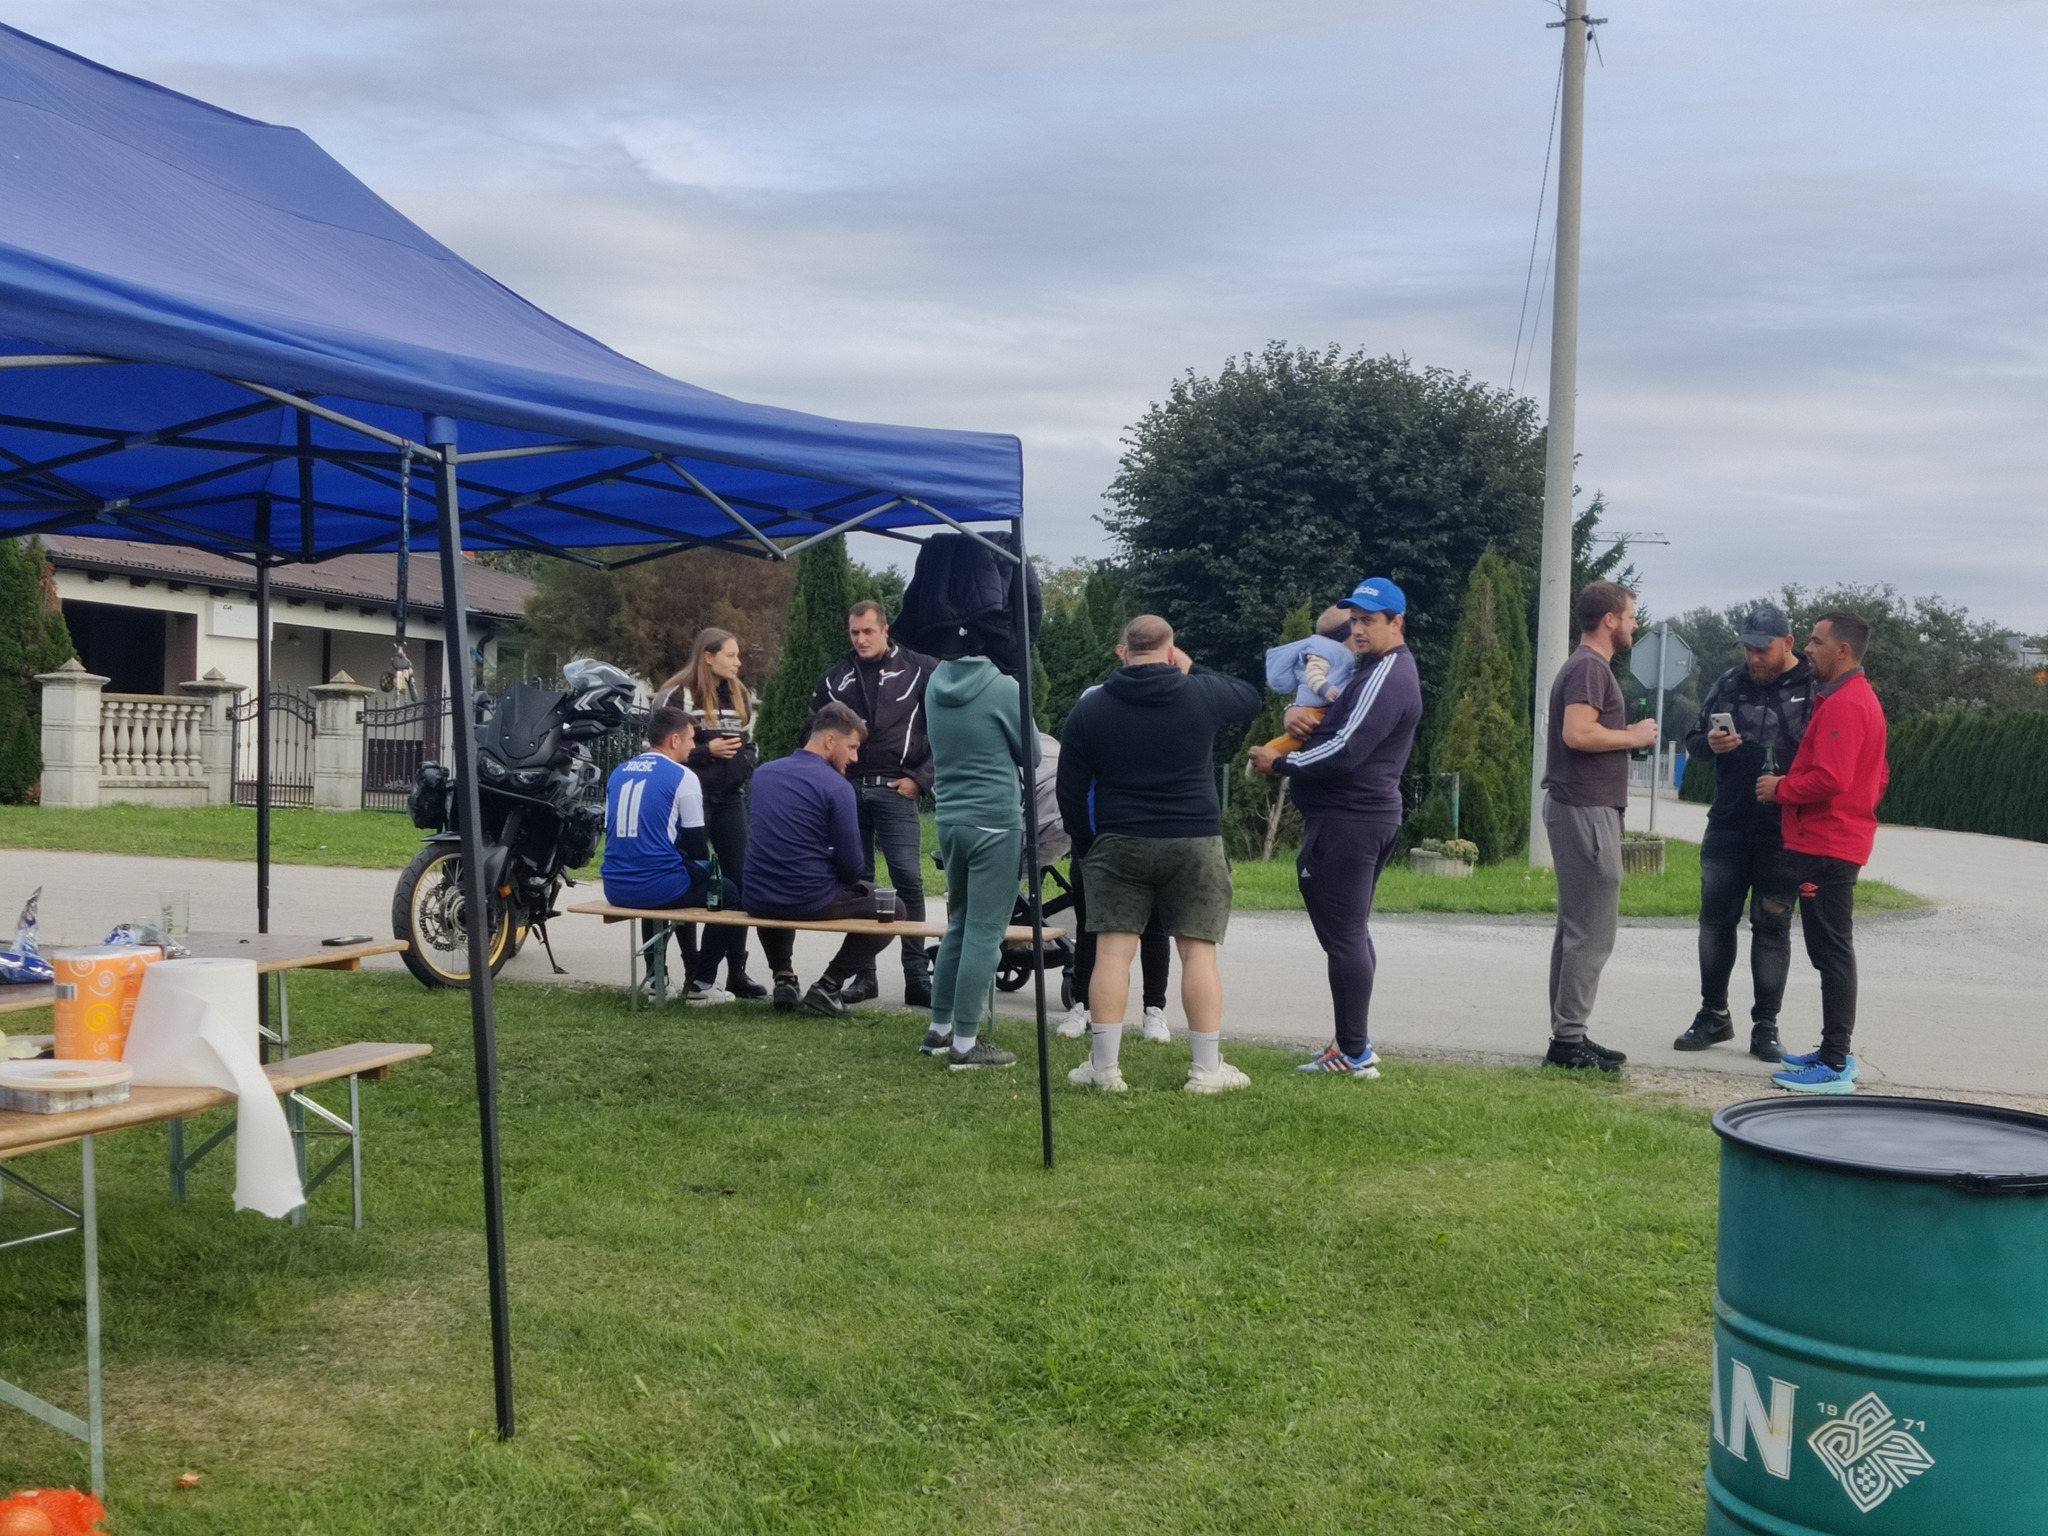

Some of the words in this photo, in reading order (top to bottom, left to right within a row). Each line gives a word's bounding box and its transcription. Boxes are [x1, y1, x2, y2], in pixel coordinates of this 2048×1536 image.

[616, 778, 647, 838] 11
[1816, 1402, 1838, 1416] 19
[1903, 1418, 1926, 1432] 71
